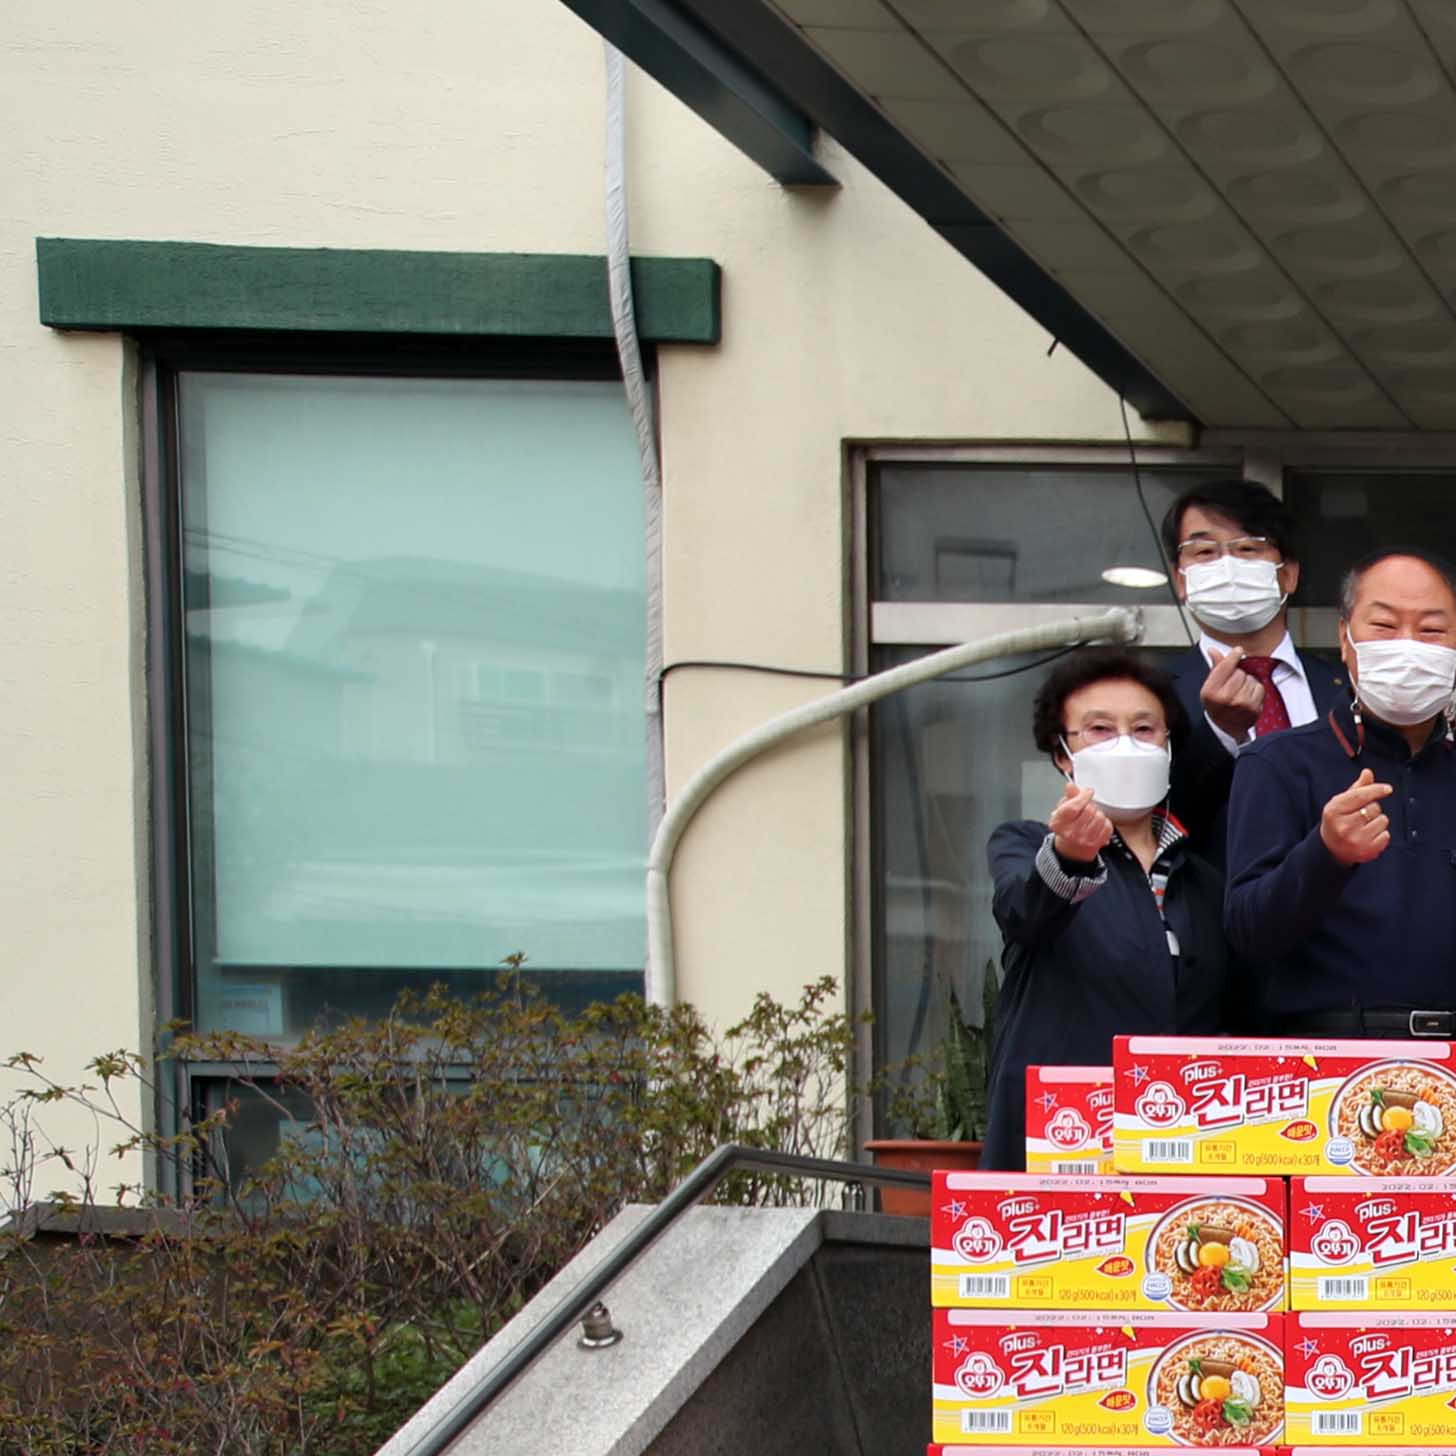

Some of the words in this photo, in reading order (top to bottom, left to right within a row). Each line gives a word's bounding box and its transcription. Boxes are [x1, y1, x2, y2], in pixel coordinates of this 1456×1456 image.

[1192, 1076, 1310, 1130] 진라면
[1009, 1212, 1127, 1266] 진라면
[1010, 1347, 1128, 1401] 진라면
